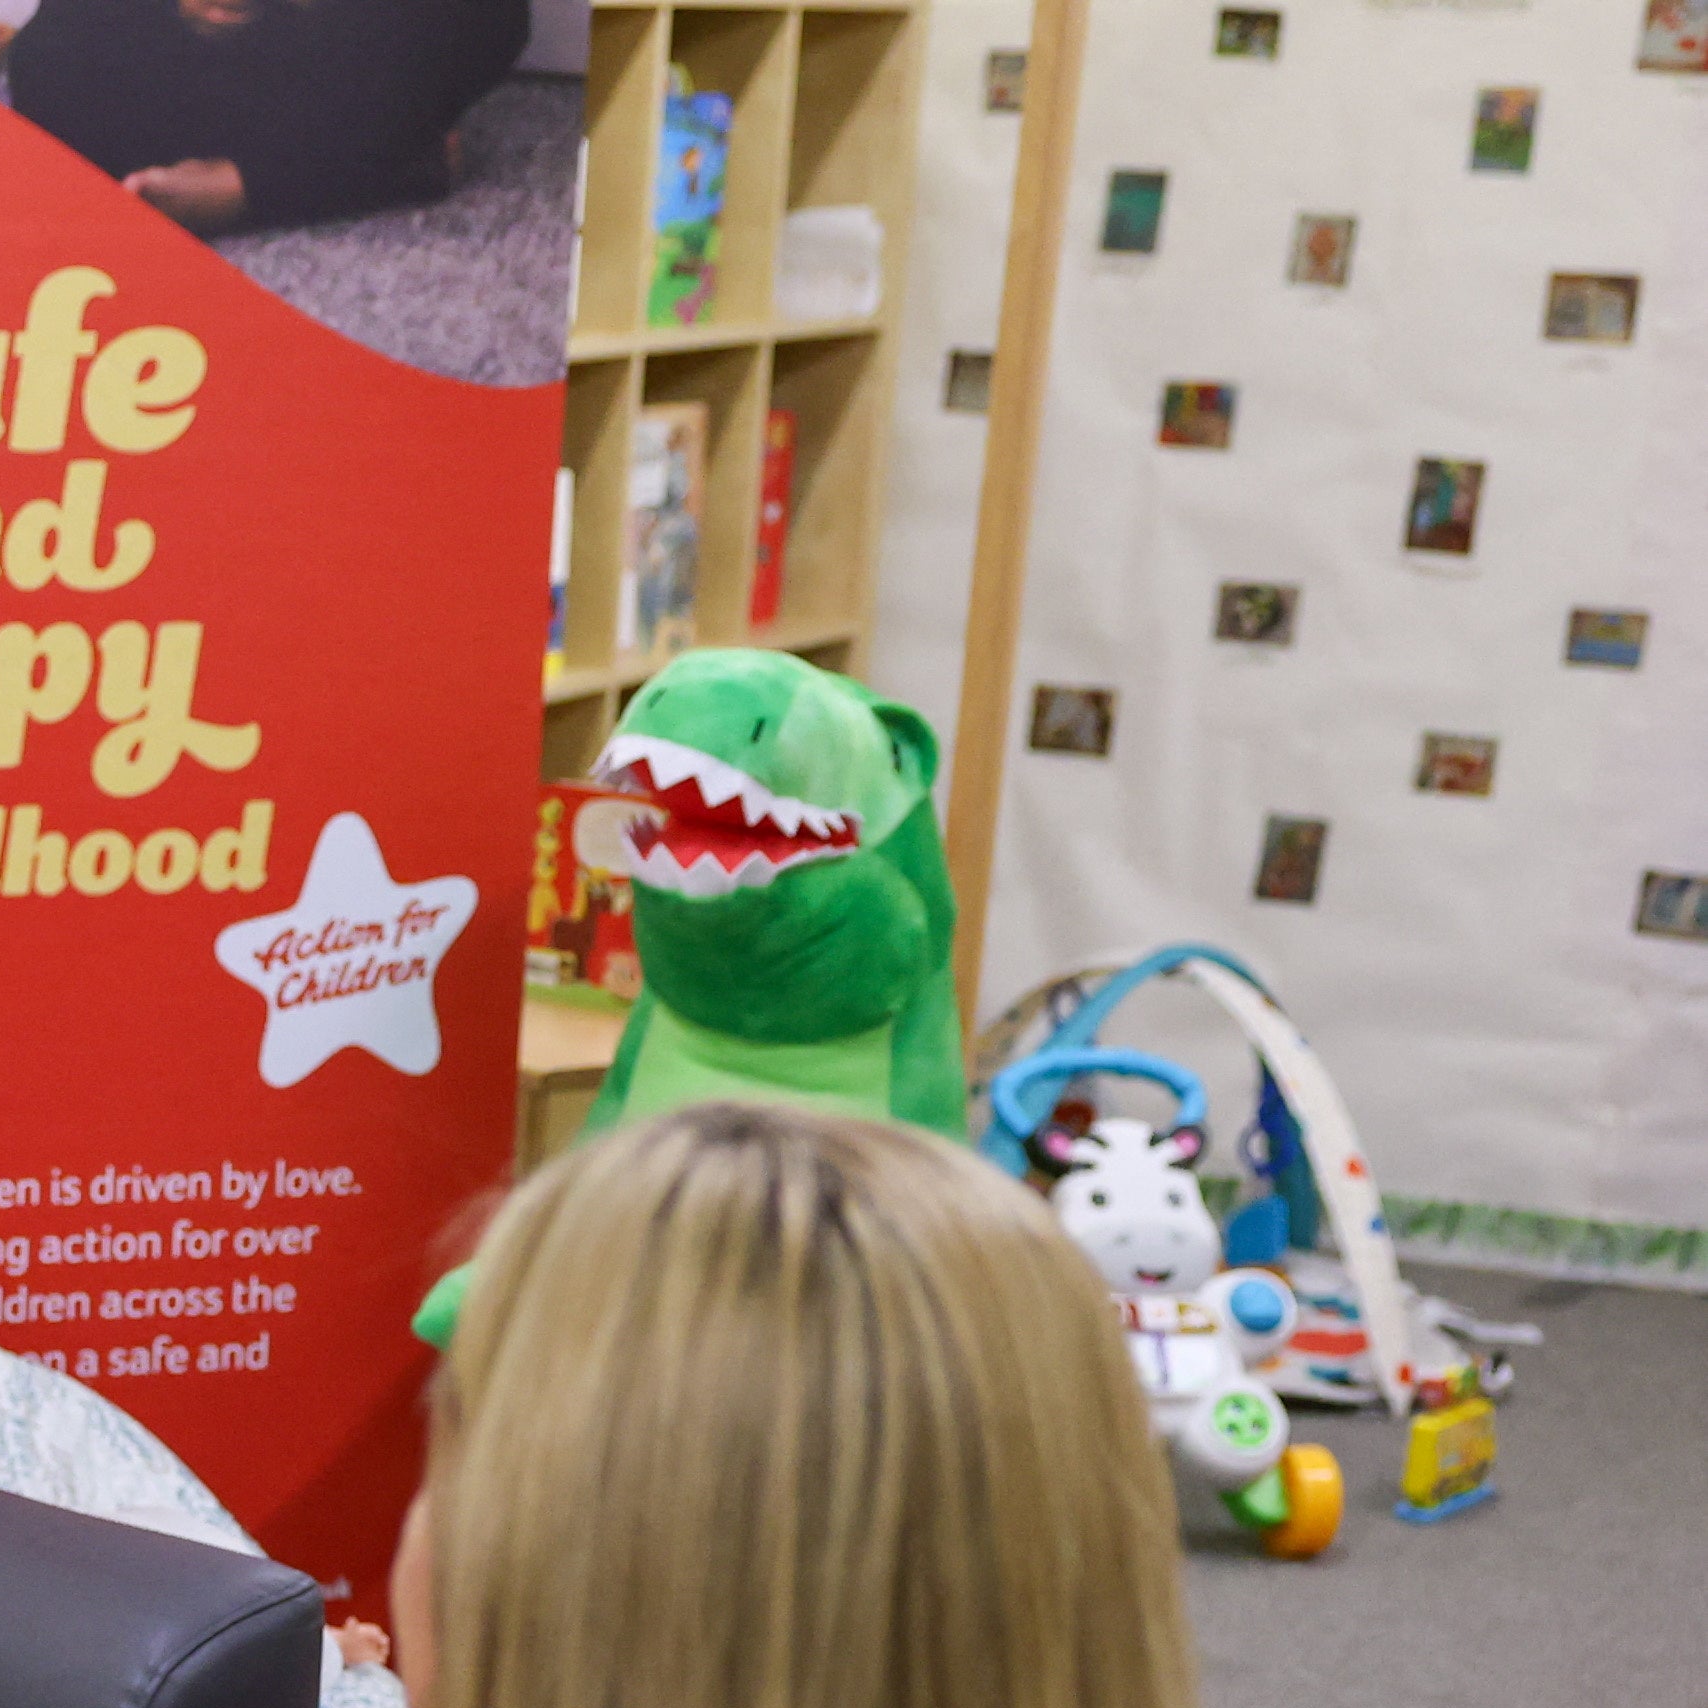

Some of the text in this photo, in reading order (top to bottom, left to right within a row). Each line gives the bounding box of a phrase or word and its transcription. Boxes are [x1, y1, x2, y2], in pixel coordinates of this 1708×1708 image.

[254, 898, 450, 972] Action for
[277, 954, 426, 1010] Children
[49, 1166, 82, 1206] is
[90, 1163, 212, 1205] driven
[221, 1160, 268, 1210] by
[274, 1158, 362, 1198] love.
[38, 1223, 162, 1265] action
[171, 1217, 229, 1260] for
[234, 1224, 320, 1258] over
[99, 1286, 223, 1320] across
[232, 1274, 297, 1314] the
[76, 1348, 99, 1378] a
[108, 1334, 189, 1377] safe
[197, 1330, 270, 1373] and
